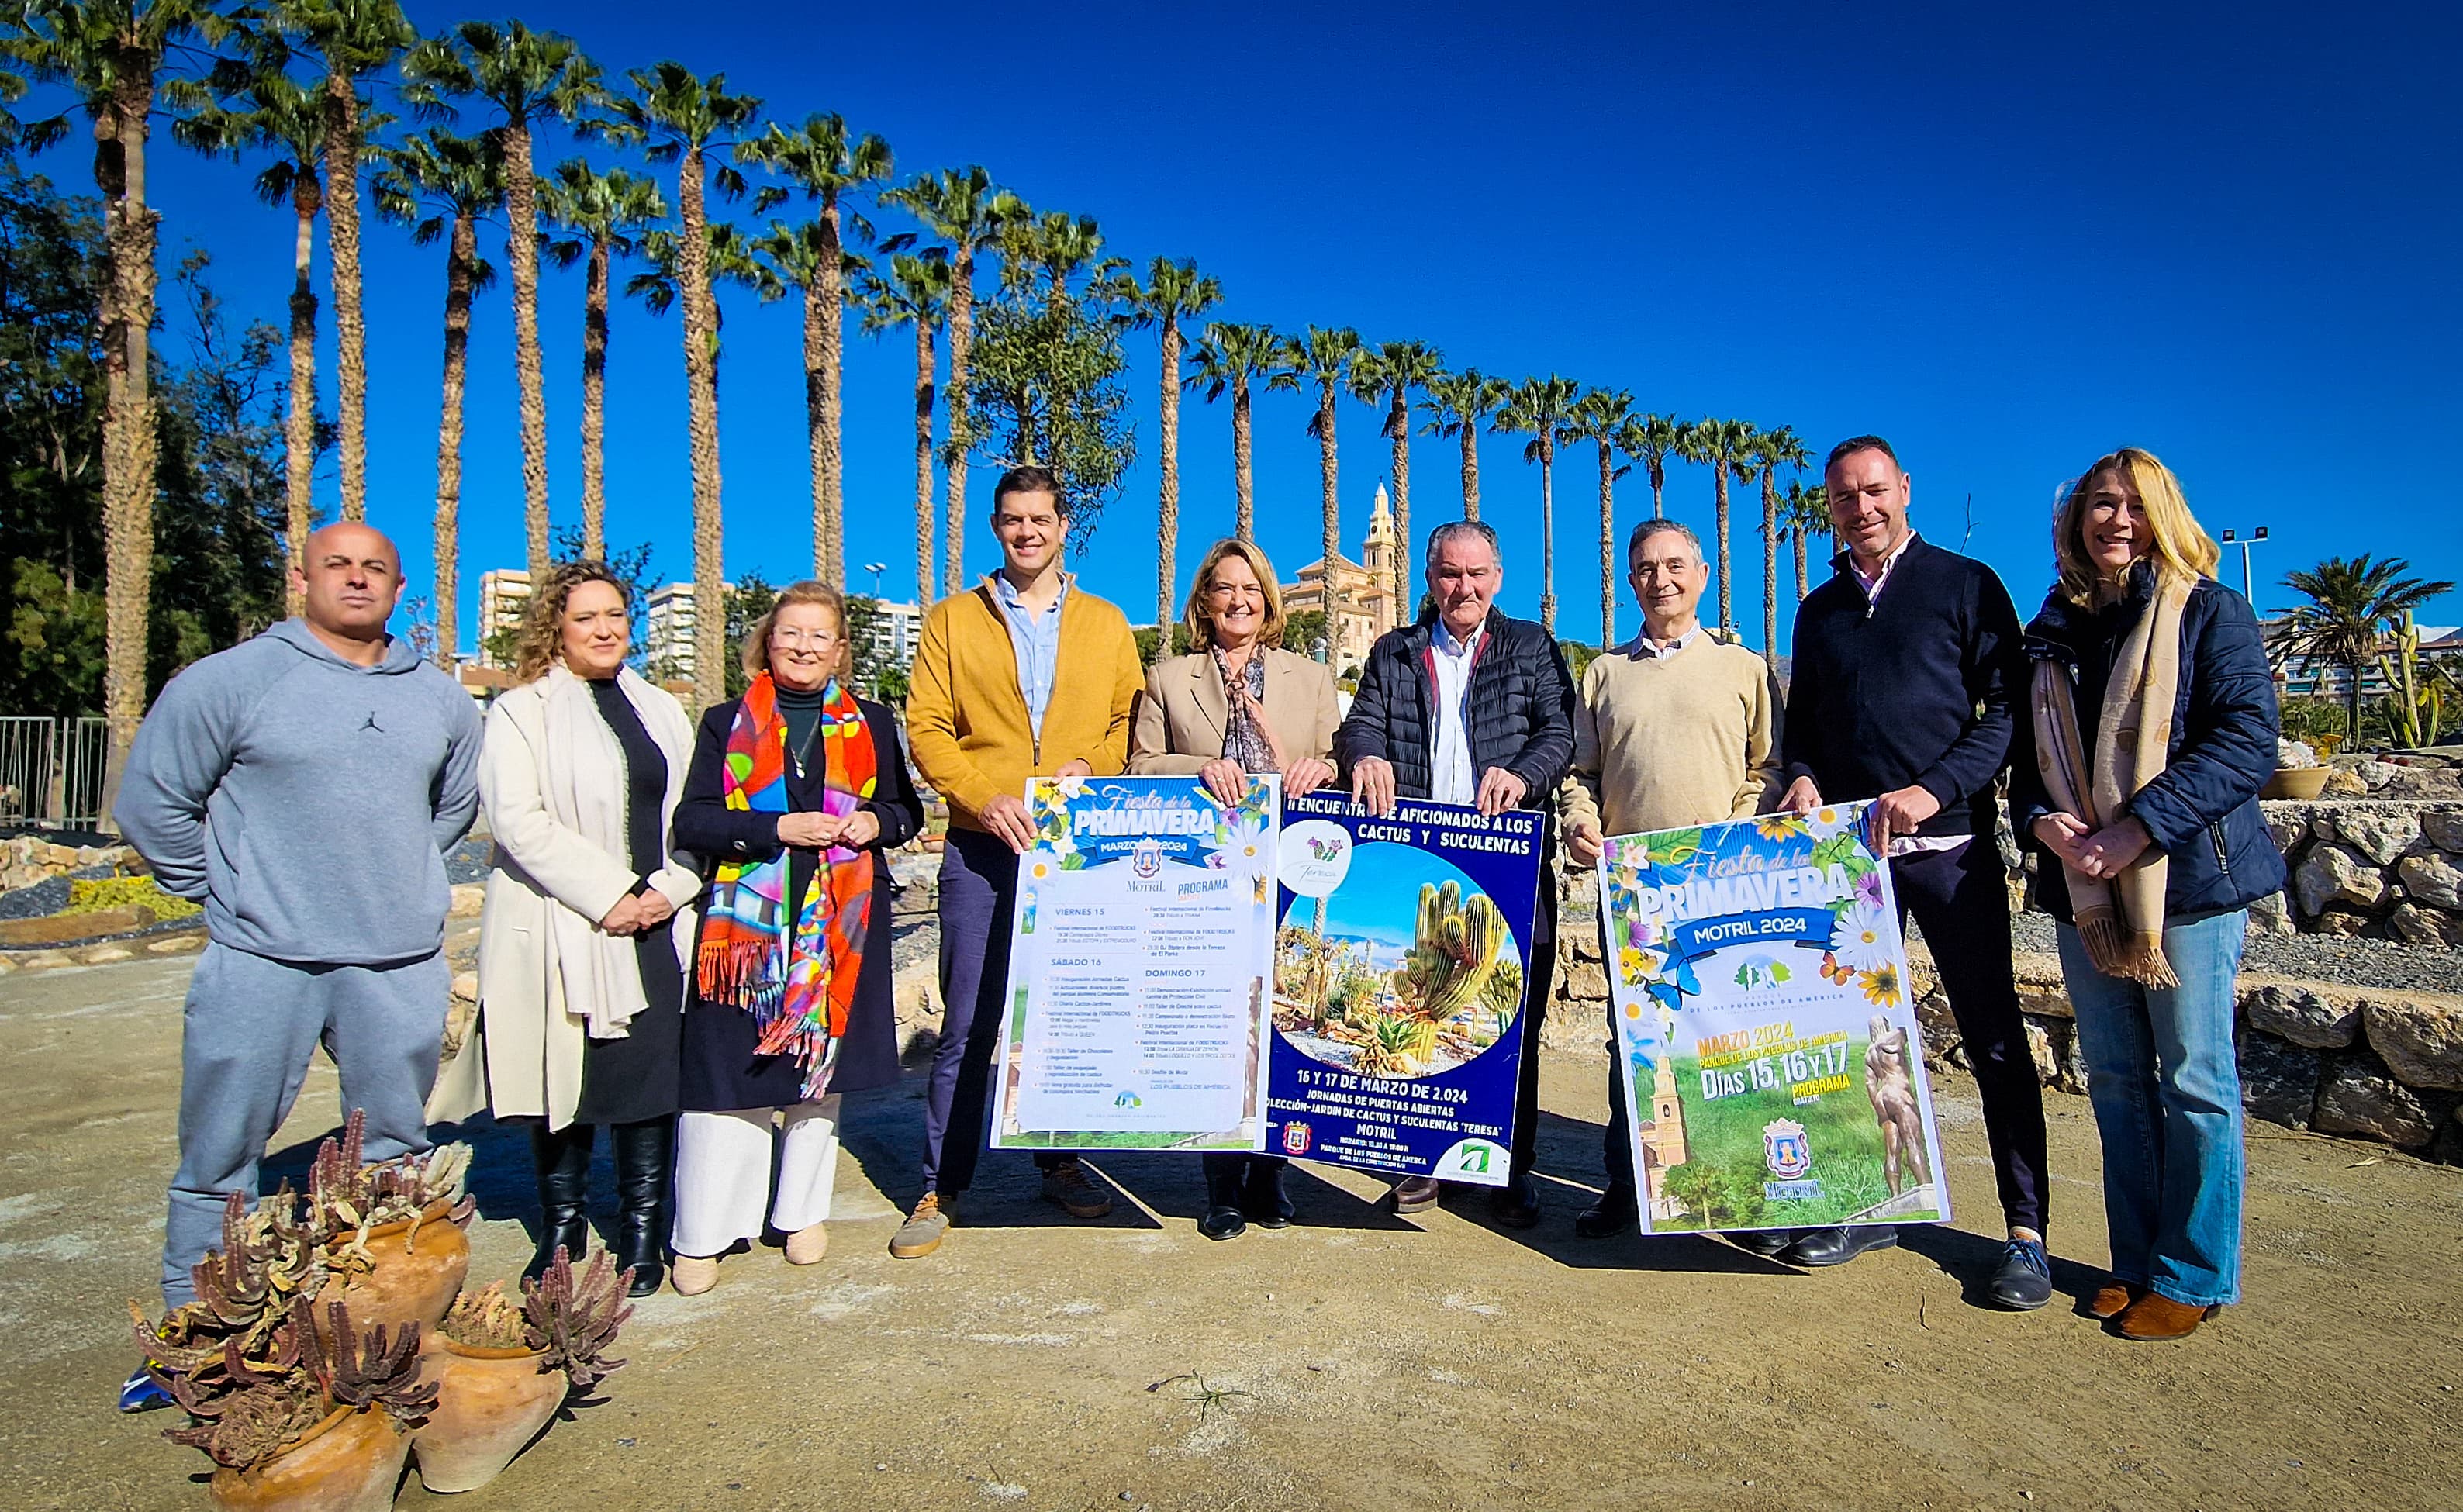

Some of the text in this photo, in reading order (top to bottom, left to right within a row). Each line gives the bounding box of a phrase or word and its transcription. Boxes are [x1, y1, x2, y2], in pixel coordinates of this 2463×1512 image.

[1092, 785, 1192, 811] Fiesta de la
[1074, 808, 1215, 835] PRIMAVERA
[1400, 808, 1490, 830] AFICIONADOS
[1493, 816, 1503, 831] A
[1506, 818, 1532, 834] LOS
[1100, 841, 1187, 852] MARZO 2024
[1358, 824, 1530, 855] CACTUS Y SUCULENTAS
[1660, 844, 1811, 888] Fiesta de la
[1178, 879, 1228, 895] PROGRAMA
[1636, 862, 1856, 925] PRIMAVERA
[1694, 917, 1807, 944] MOTRIL 2024
[1730, 1000, 1774, 1009] PUEBLOS
[1696, 1020, 1795, 1057] MARZO 2024
[1698, 1055, 1731, 1069] PARQUE
[1732, 1051, 1743, 1063] DE
[1744, 1049, 1759, 1060] LOS
[1761, 1040, 1797, 1056] PUEBLOS
[1798, 1037, 1809, 1048] DE
[1746, 1057, 1781, 1091] 15,
[1779, 1050, 1808, 1084] 16
[1822, 1041, 1849, 1075] 17
[1297, 1069, 1468, 1104] 16 Y 17 DE MARZO DE 2.024
[1792, 1073, 1850, 1099] PROGRAMA
[1306, 1089, 1455, 1117] JORNADAS DE PUERTAS ABIERTAS
[1343, 1108, 1356, 1118] DE
[1356, 1110, 1392, 1124] CACTUS
[1394, 1114, 1401, 1124] Y
[1401, 1115, 1458, 1131] SUCULENTAS
[1356, 1123, 1397, 1140] MOTRIL
[1320, 1144, 1344, 1154] PARQUE
[1354, 1148, 1365, 1157] LOS
[1366, 1150, 1392, 1161] PUEBLOS
[1404, 1144, 1409, 1153] H
